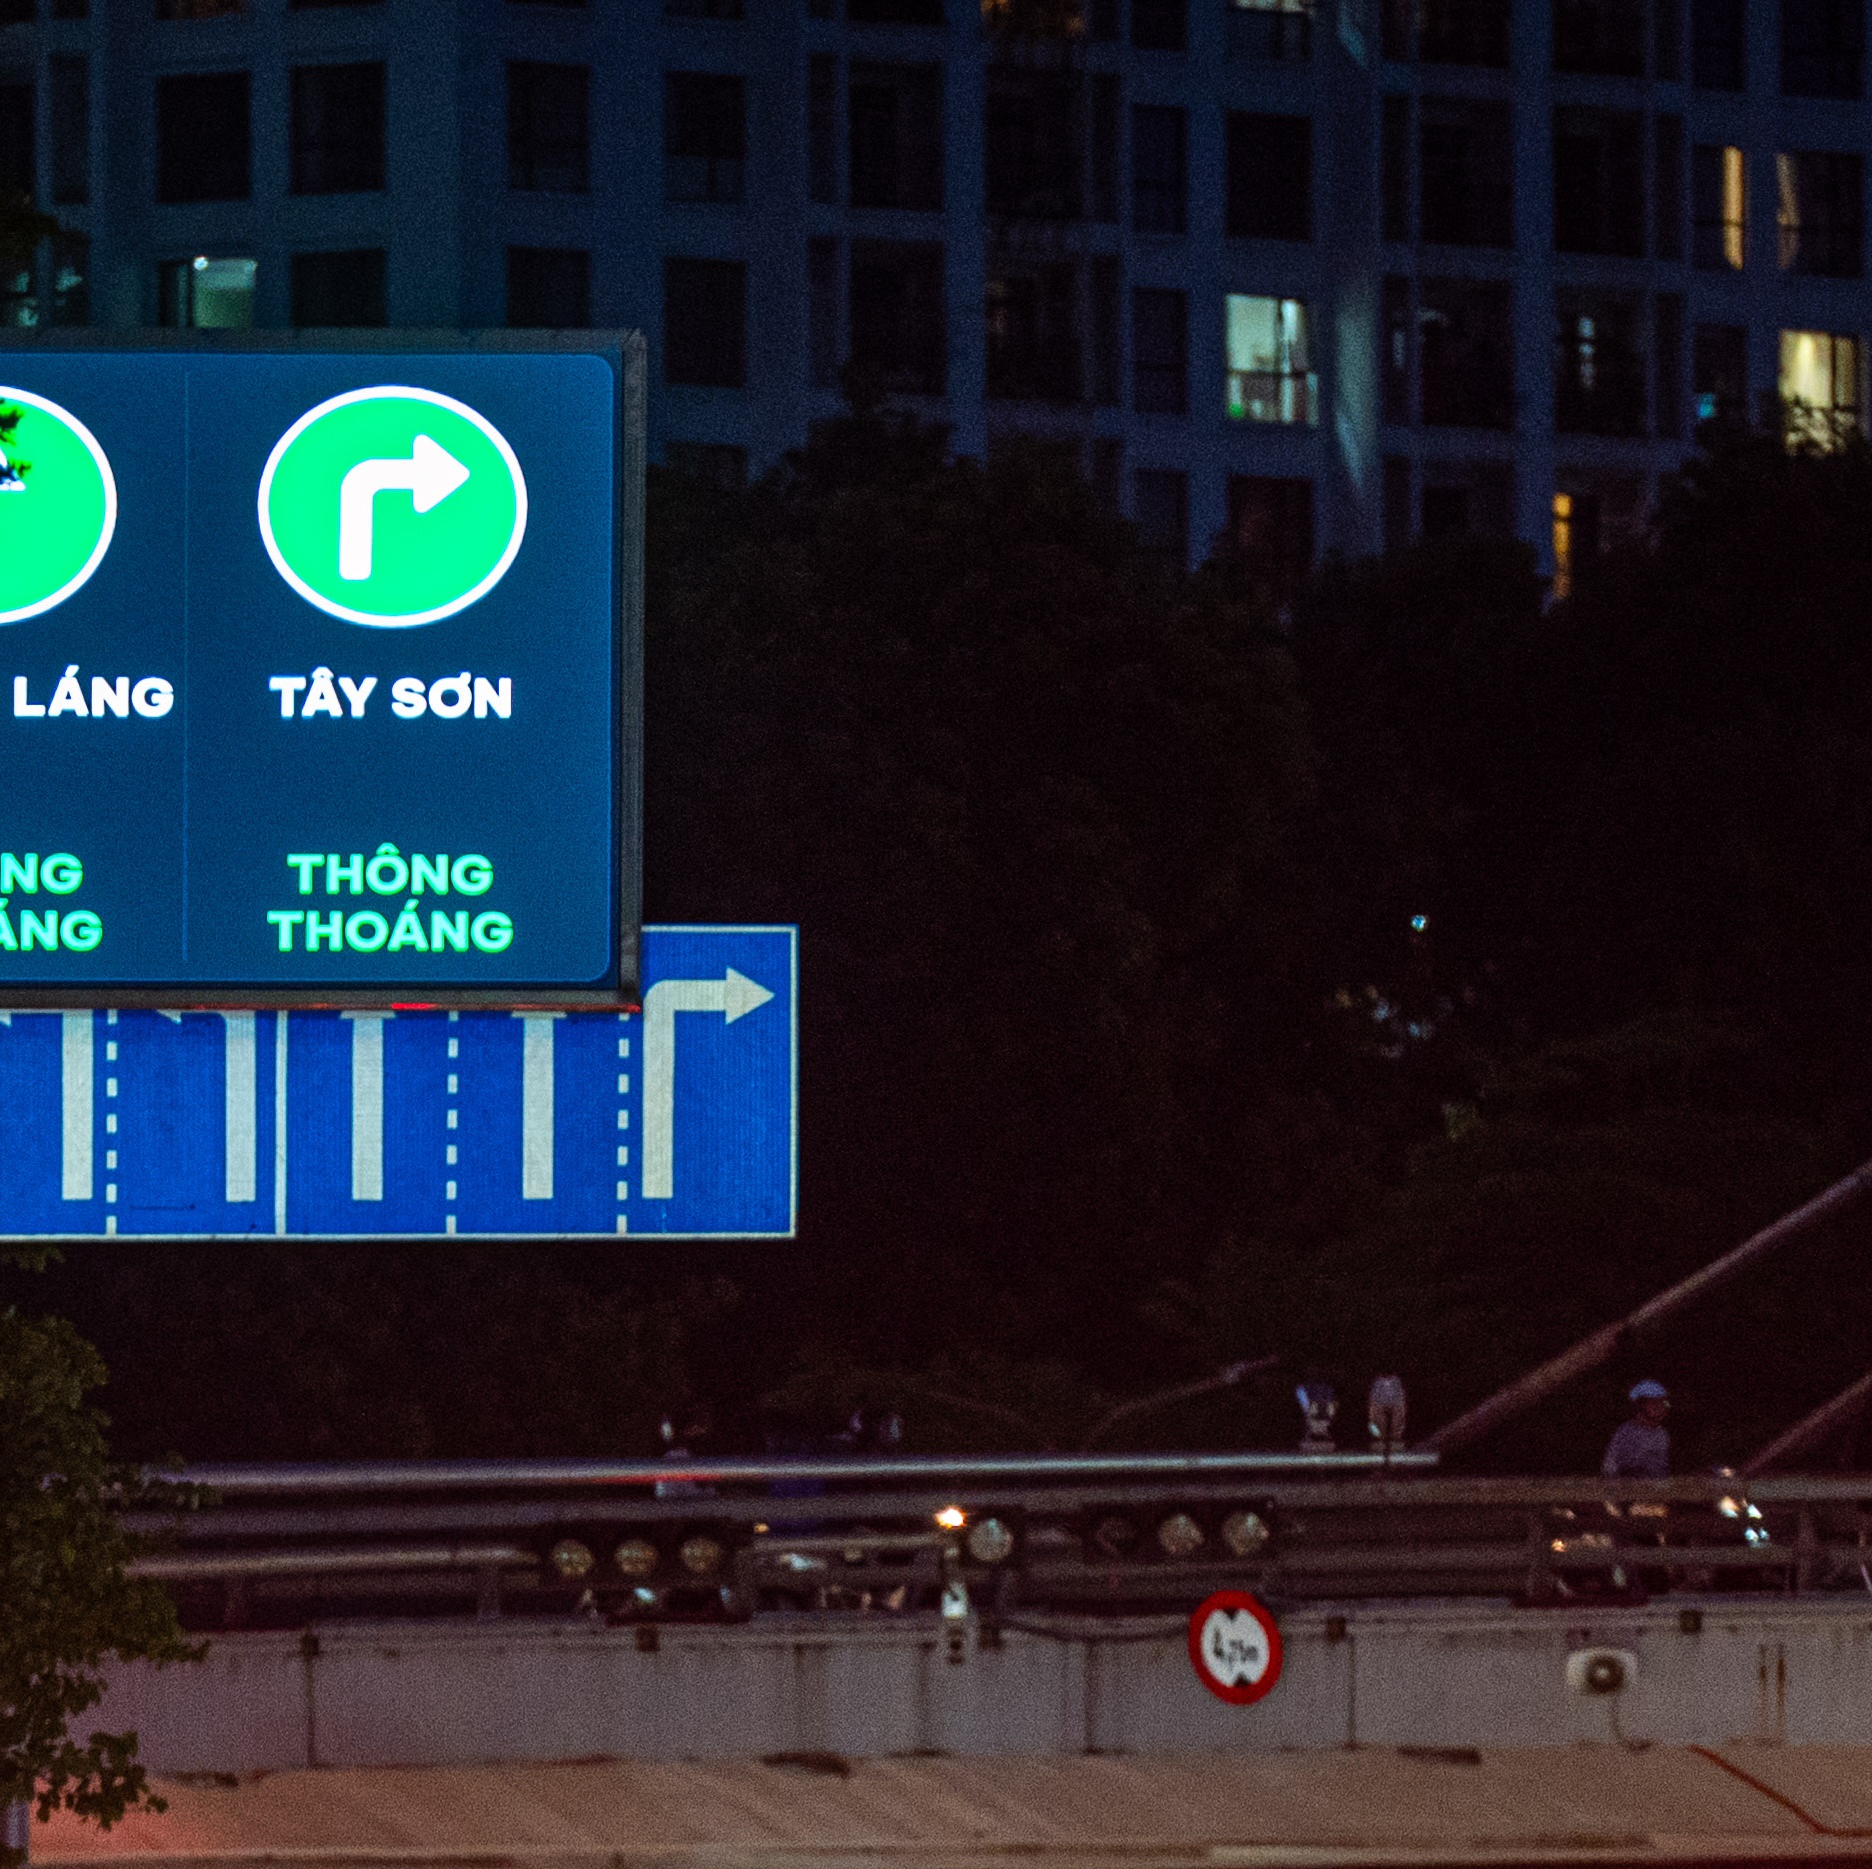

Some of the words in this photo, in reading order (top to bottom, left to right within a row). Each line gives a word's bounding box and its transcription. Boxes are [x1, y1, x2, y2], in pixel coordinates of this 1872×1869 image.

[13, 665, 175, 718] LÁNG
[268, 666, 378, 719] TÂY
[391, 671, 513, 719] SƠN
[286, 842, 494, 896] THÔNG
[266, 898, 514, 954] THOÁNG
